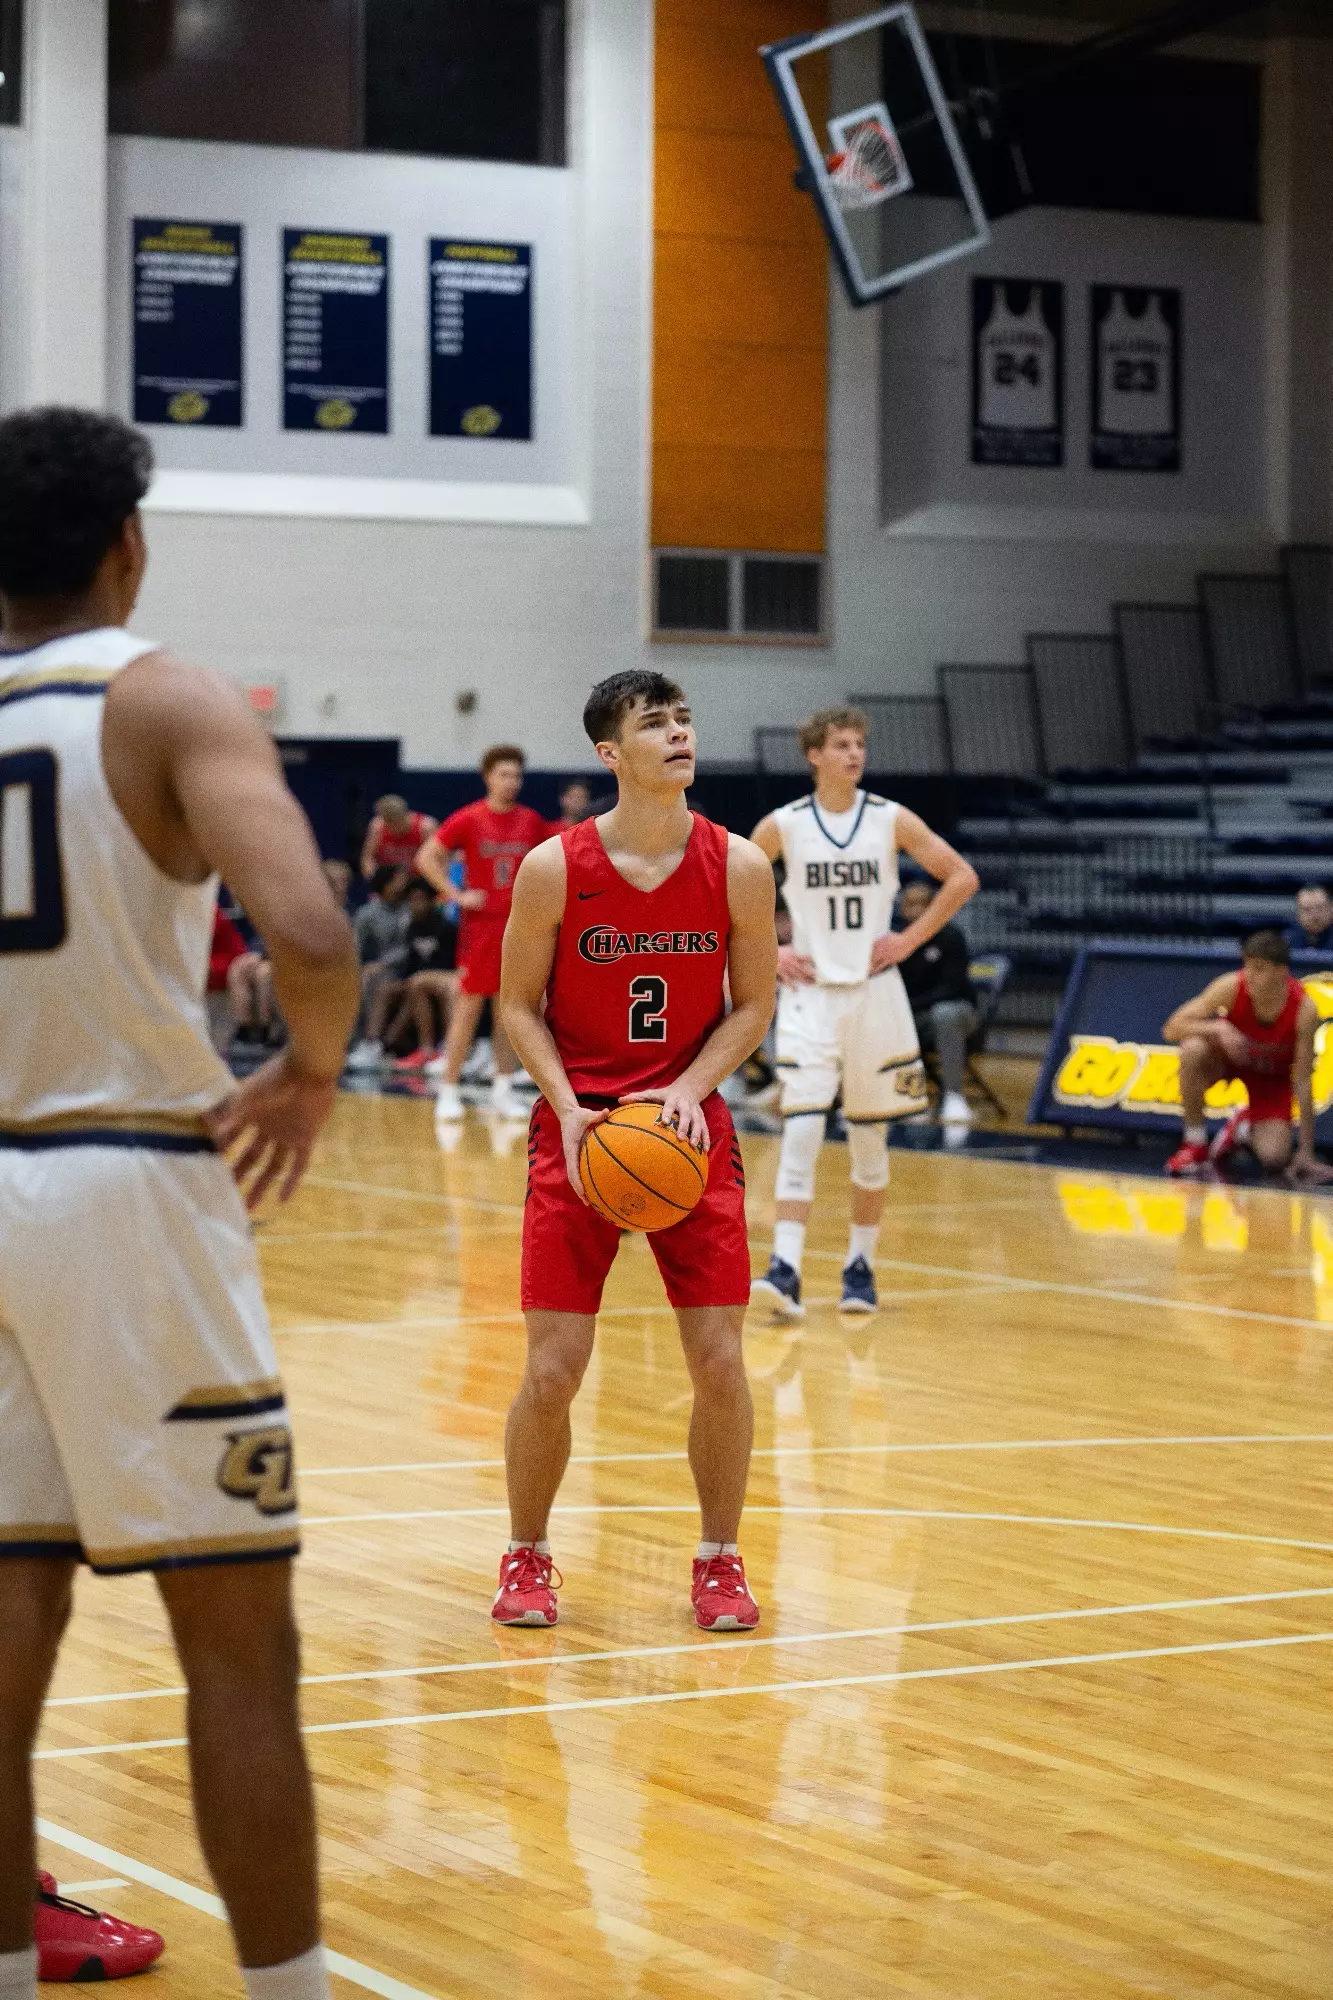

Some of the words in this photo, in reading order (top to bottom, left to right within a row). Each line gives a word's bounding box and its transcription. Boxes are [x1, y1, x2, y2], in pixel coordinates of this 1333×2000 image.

[806, 858, 880, 889] BISON
[827, 895, 863, 930] 10
[578, 924, 720, 965] CHARGERS
[628, 975, 668, 1043] 2
